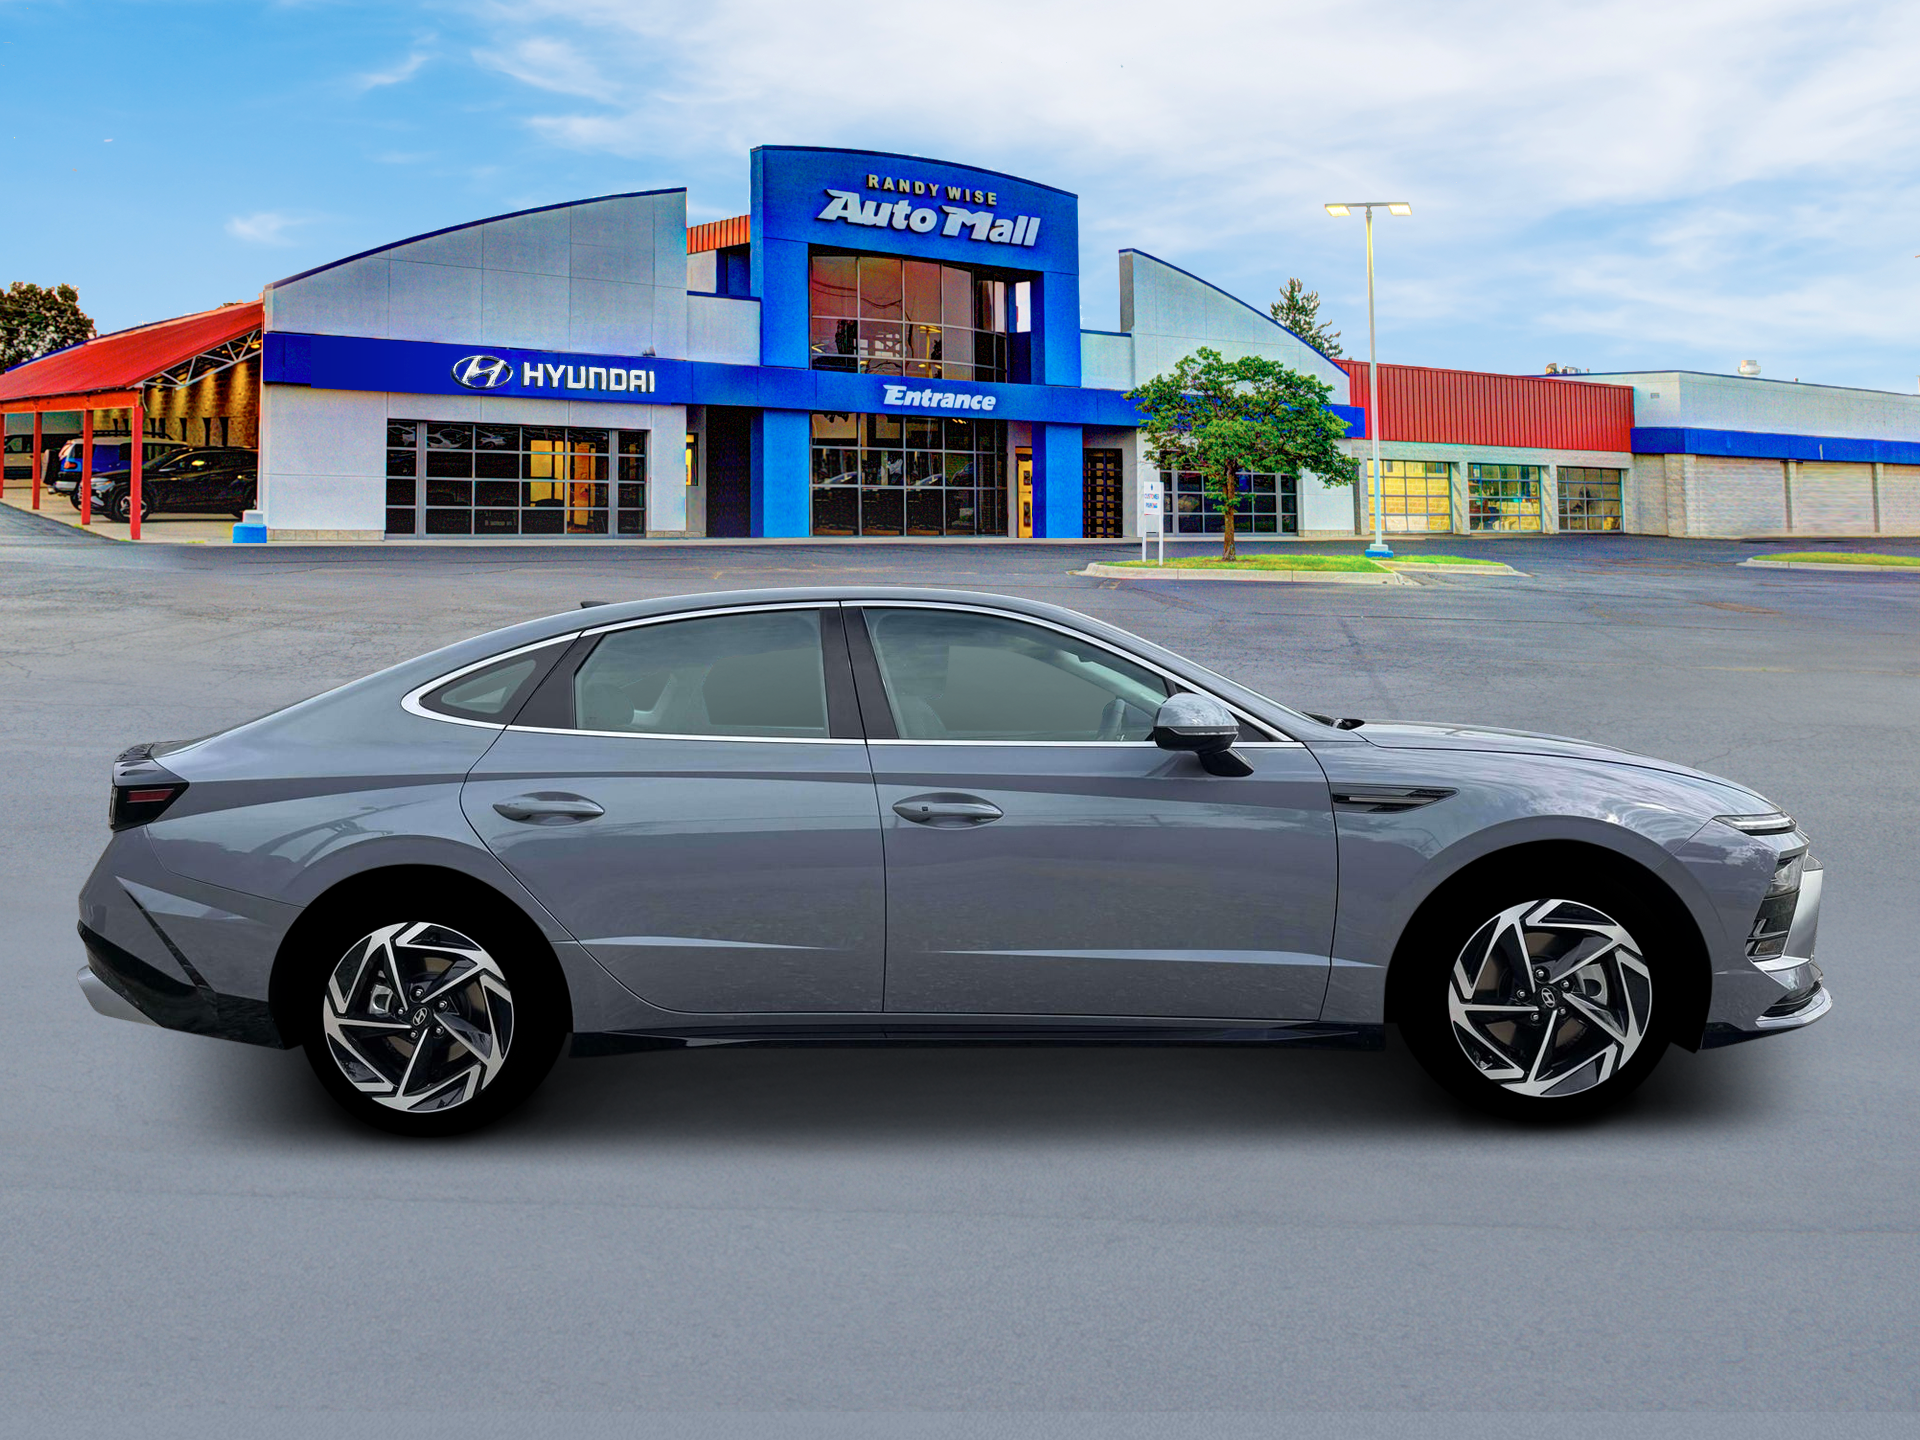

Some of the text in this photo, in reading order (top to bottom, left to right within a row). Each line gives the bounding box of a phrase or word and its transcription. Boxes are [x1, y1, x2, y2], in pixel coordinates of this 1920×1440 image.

[867, 173, 997, 206] RANDY WISE
[817, 188, 1041, 247] Auto Mall
[522, 361, 656, 393] HYUNDAI
[883, 384, 996, 411] Entrance
